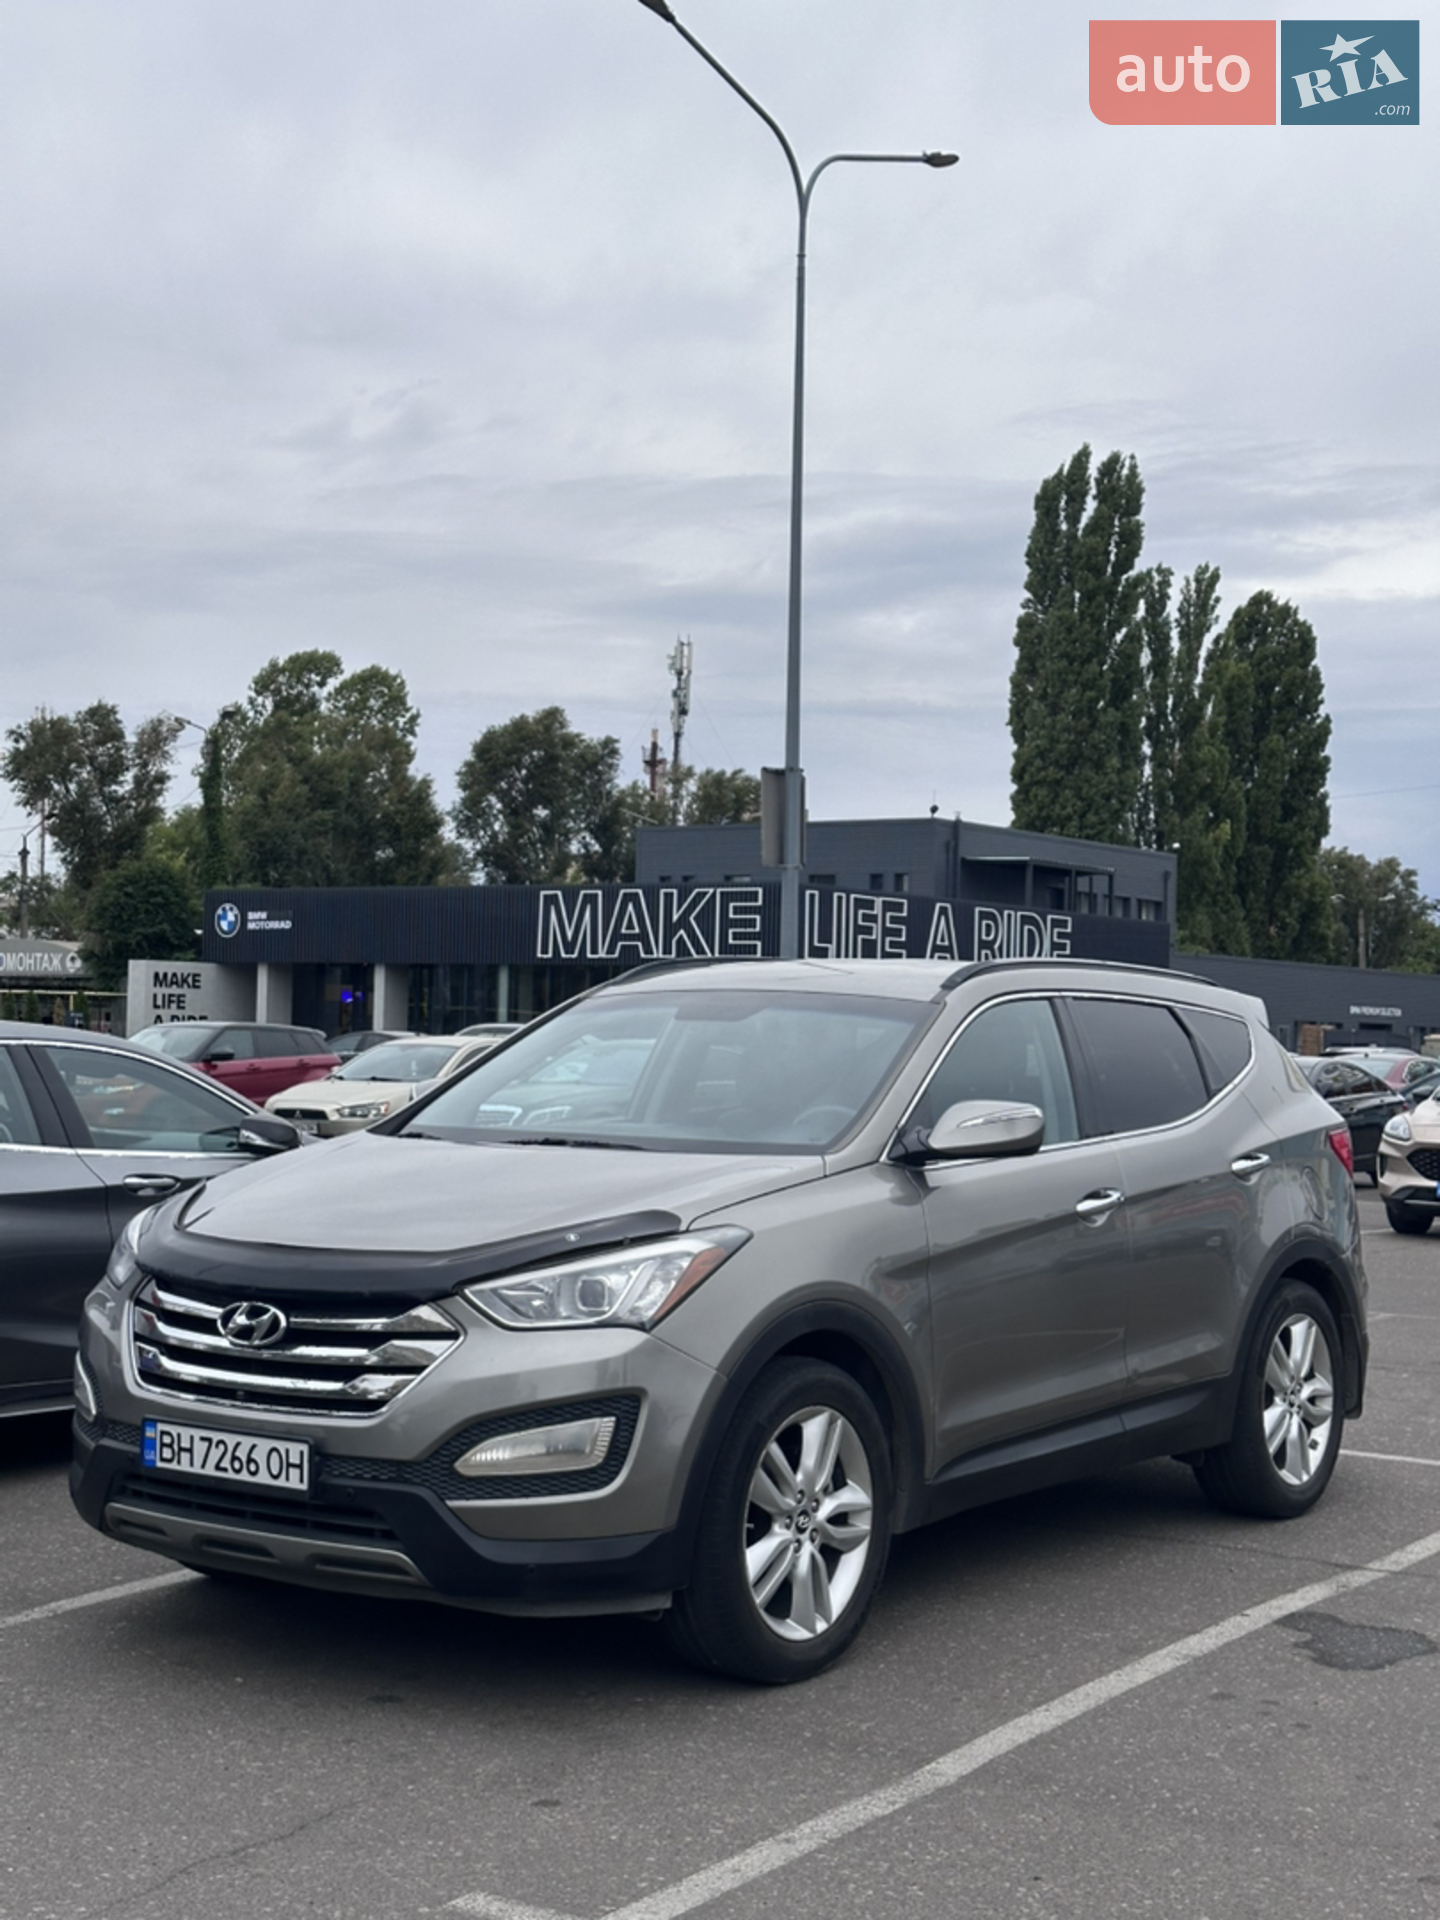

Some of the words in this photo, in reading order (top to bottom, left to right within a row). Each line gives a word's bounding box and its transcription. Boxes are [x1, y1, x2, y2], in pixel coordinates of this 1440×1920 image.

[537, 887, 763, 958] MAKE
[805, 890, 907, 959] LIFE
[926, 902, 958, 961] A
[974, 906, 1072, 961] RIDE
[153, 971, 201, 989] MAKE
[153, 993, 186, 1010] LIFE
[199, 1436, 260, 1477] 7266
